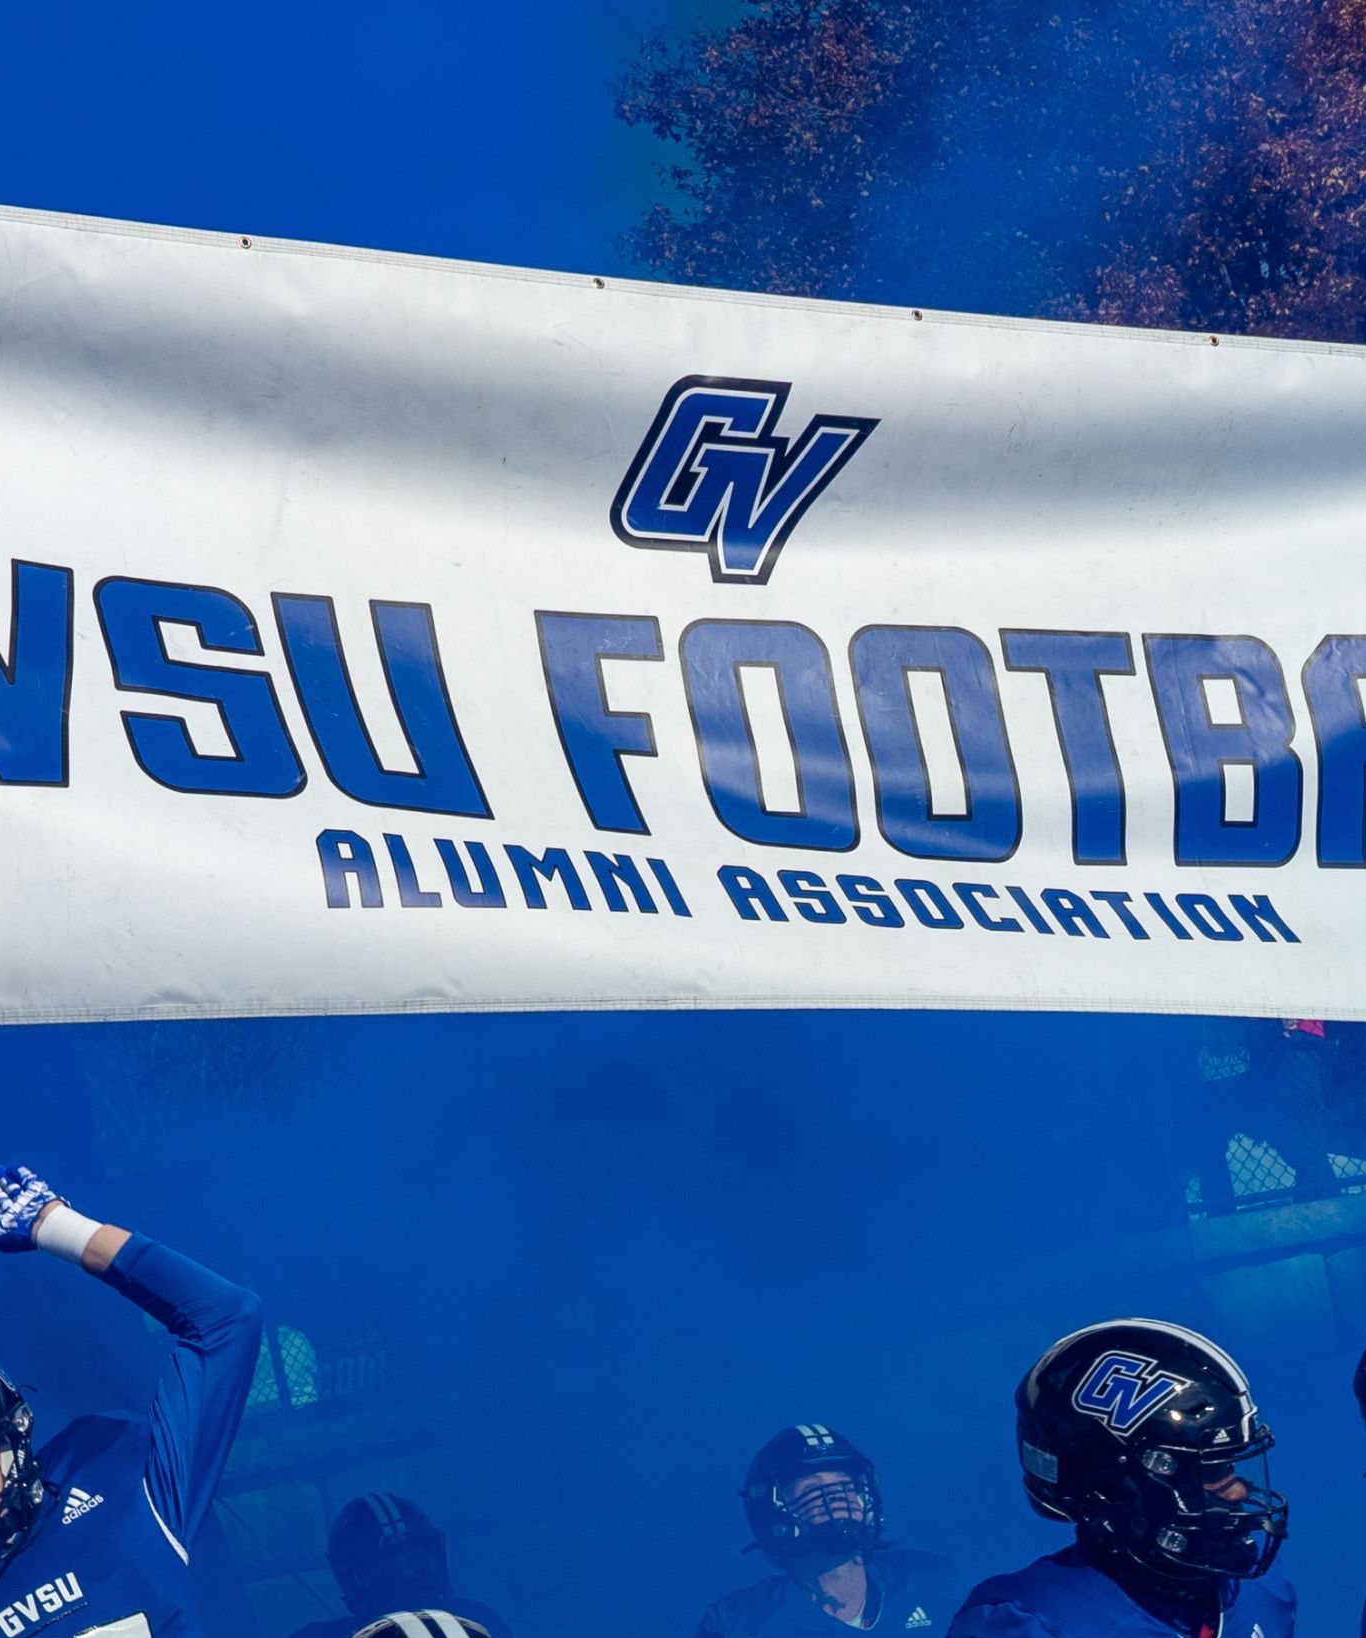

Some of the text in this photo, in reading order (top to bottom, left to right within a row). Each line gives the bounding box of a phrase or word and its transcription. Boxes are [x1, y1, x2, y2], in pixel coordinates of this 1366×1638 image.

[611, 374, 880, 584] GV
[316, 828, 1302, 943] ALUMNI ASSOCIATION
[1073, 1350, 1191, 1436] GV
[61, 1494, 104, 1524] adidas
